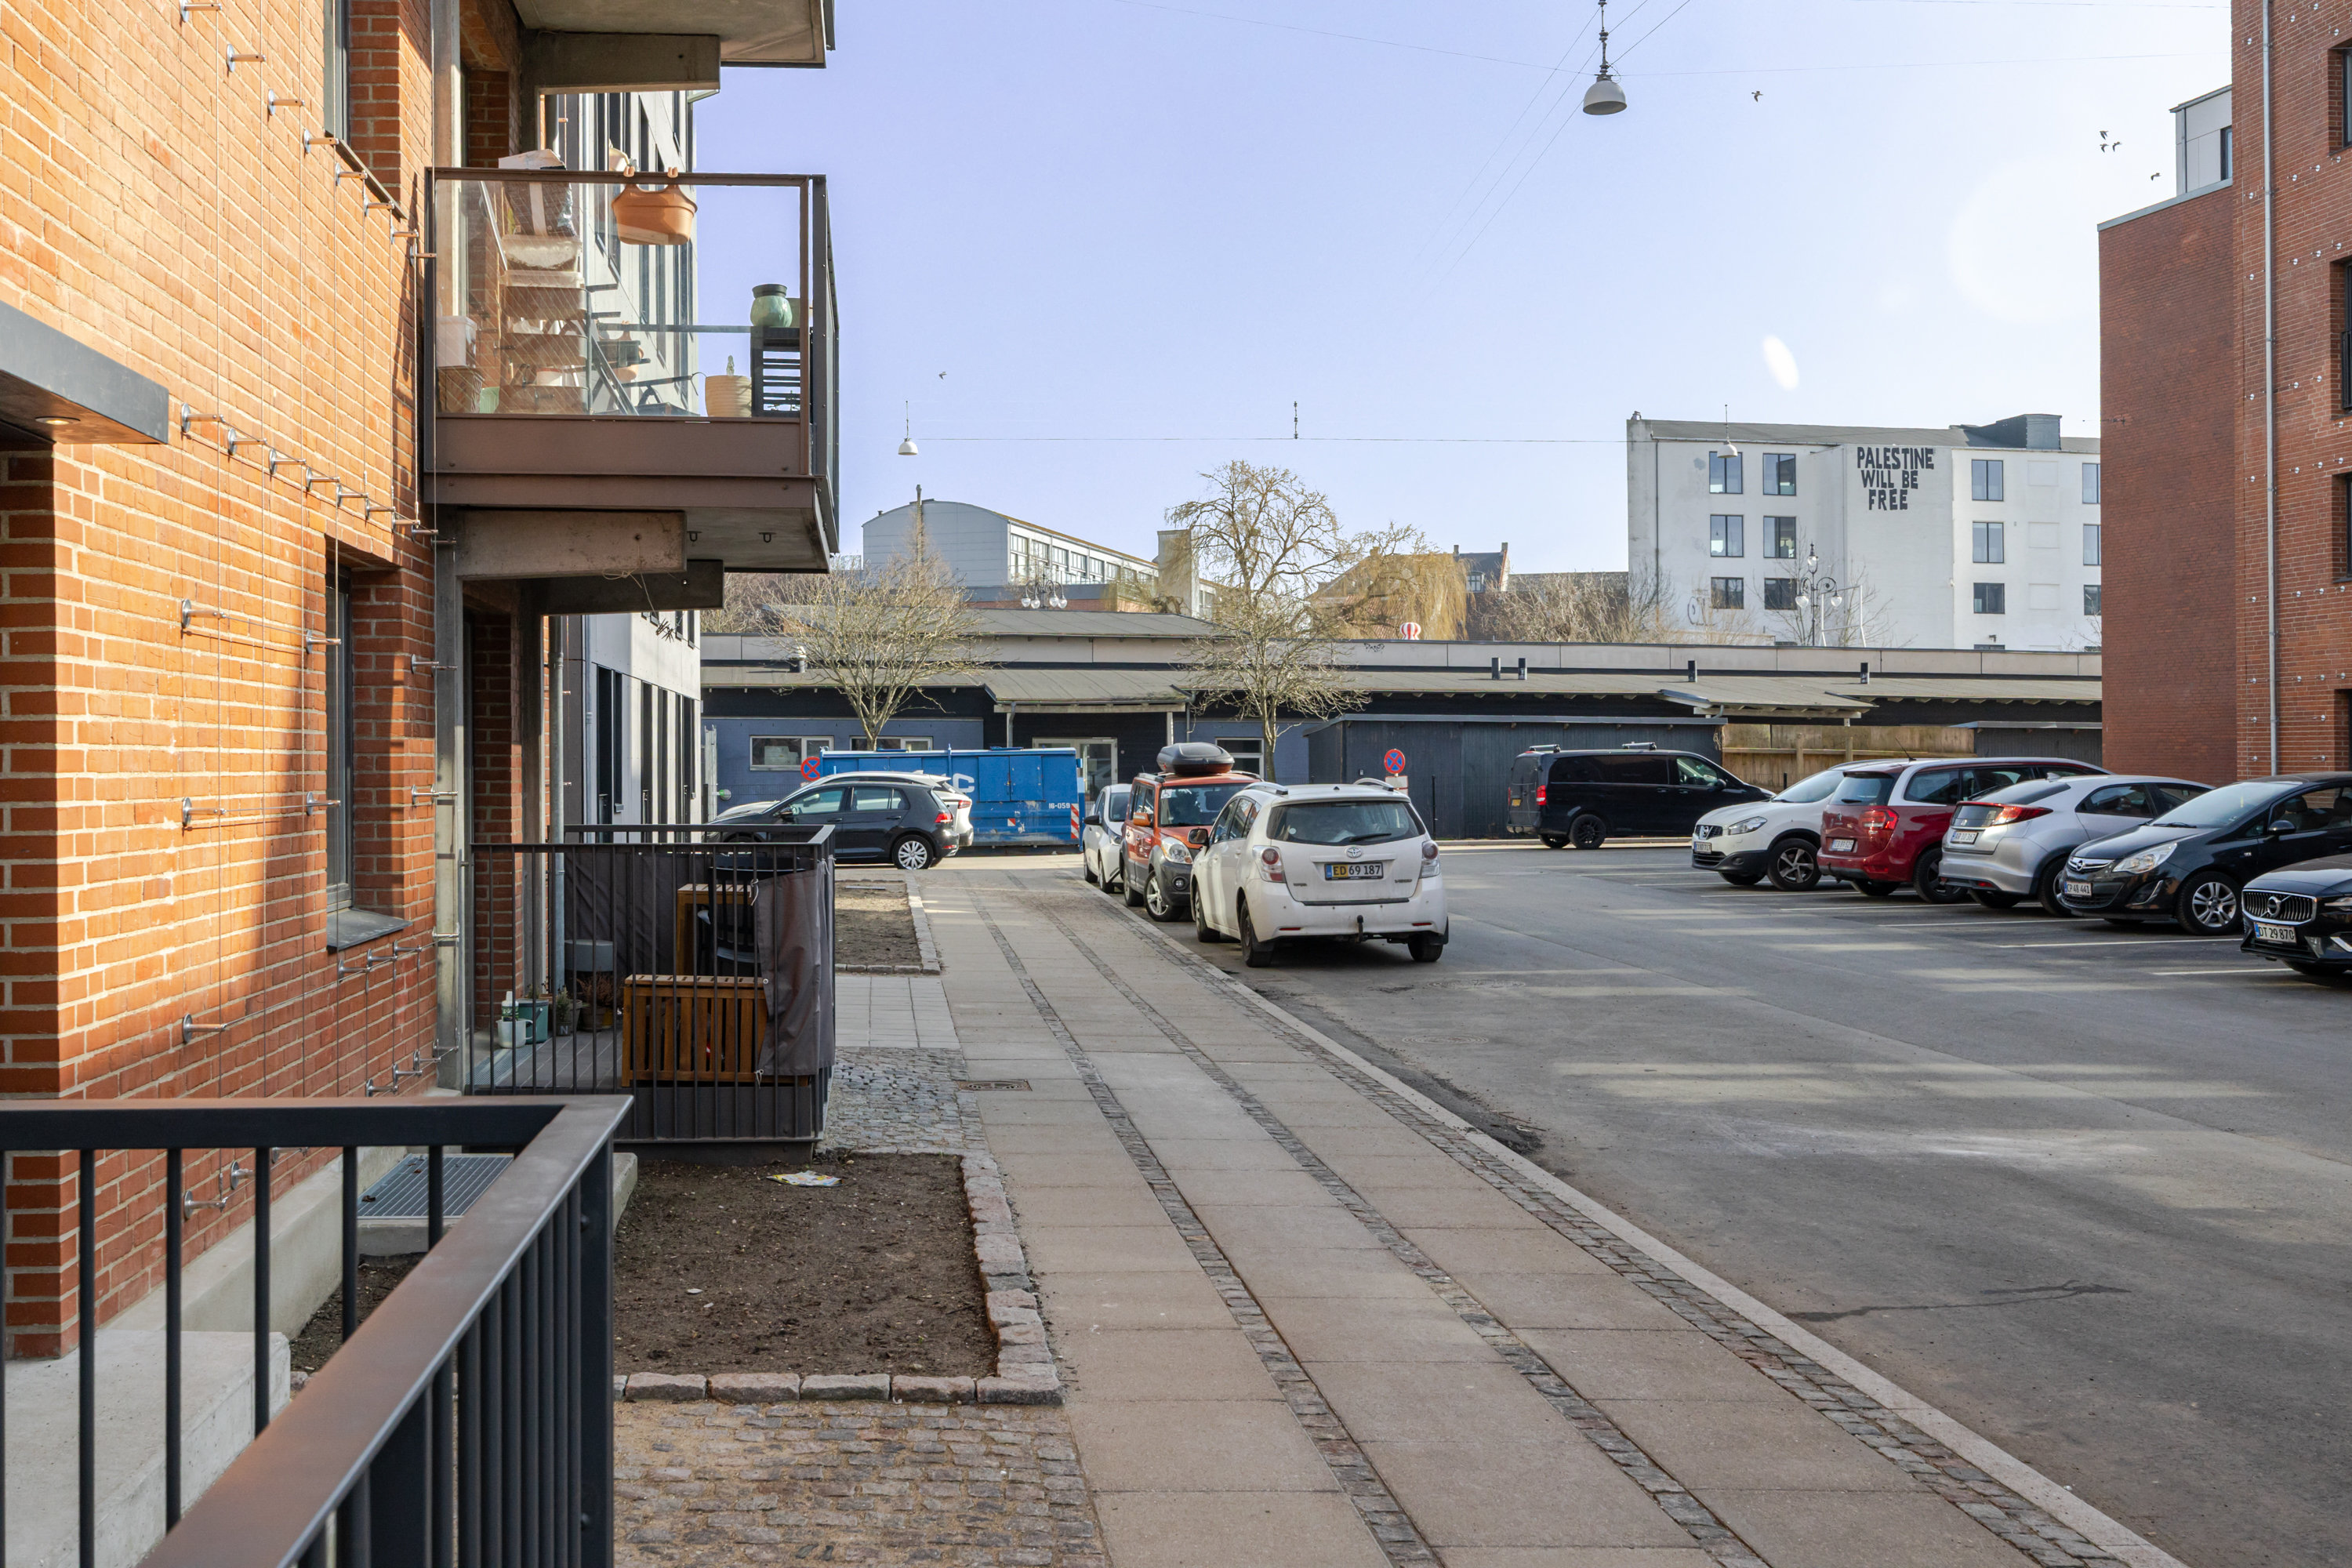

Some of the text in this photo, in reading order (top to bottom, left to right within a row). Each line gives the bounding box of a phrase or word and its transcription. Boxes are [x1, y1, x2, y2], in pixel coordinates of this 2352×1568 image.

[1857, 446, 1934, 470] PALESTINE
[1860, 470, 1918, 489] WILL BE
[1868, 488, 1907, 510] FREE
[1333, 865, 1381, 876] ED 69 187
[2080, 885, 2090, 894] 441
[2259, 927, 2267, 937] DT
[2269, 927, 2278, 938] 29
